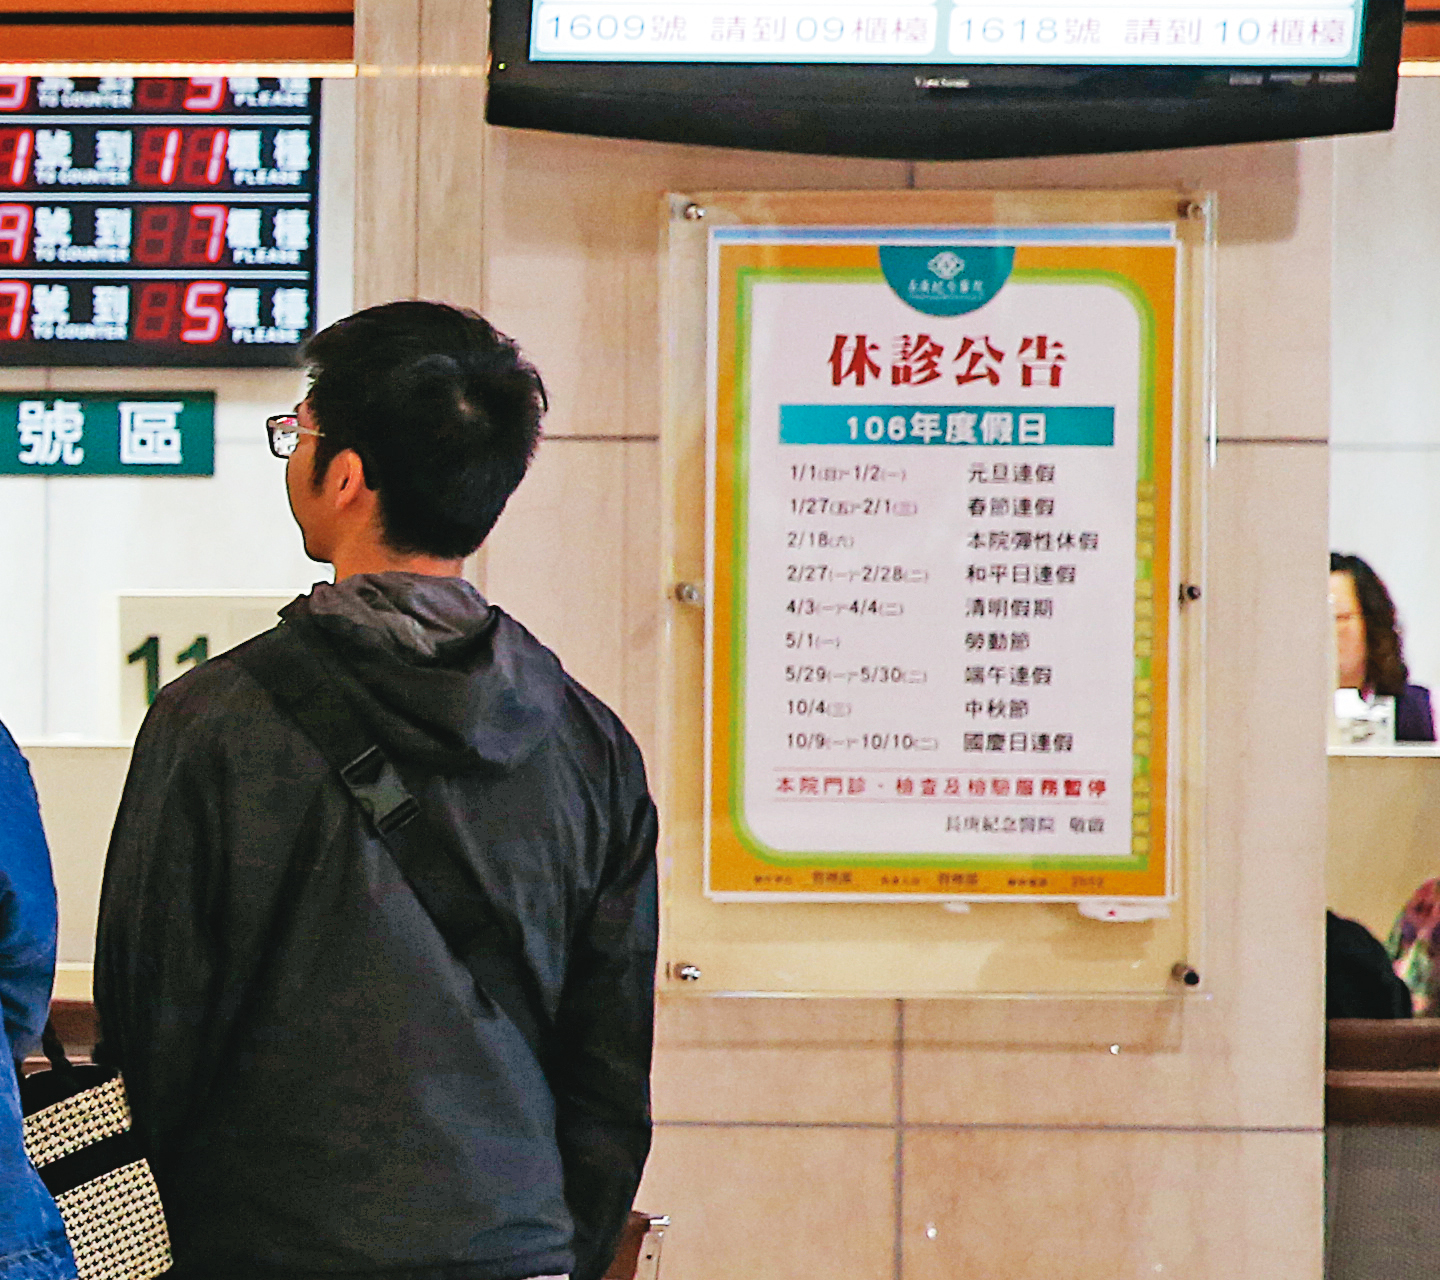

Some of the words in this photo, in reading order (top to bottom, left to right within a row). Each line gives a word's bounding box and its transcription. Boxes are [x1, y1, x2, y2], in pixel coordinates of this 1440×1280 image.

[159, 129, 228, 185] 11
[191, 205, 227, 263] 7
[180, 281, 226, 342] 5
[828, 334, 1067, 387] 休診公告
[847, 413, 1046, 445] 106年度假日
[969, 462, 1055, 483] 元旦連假
